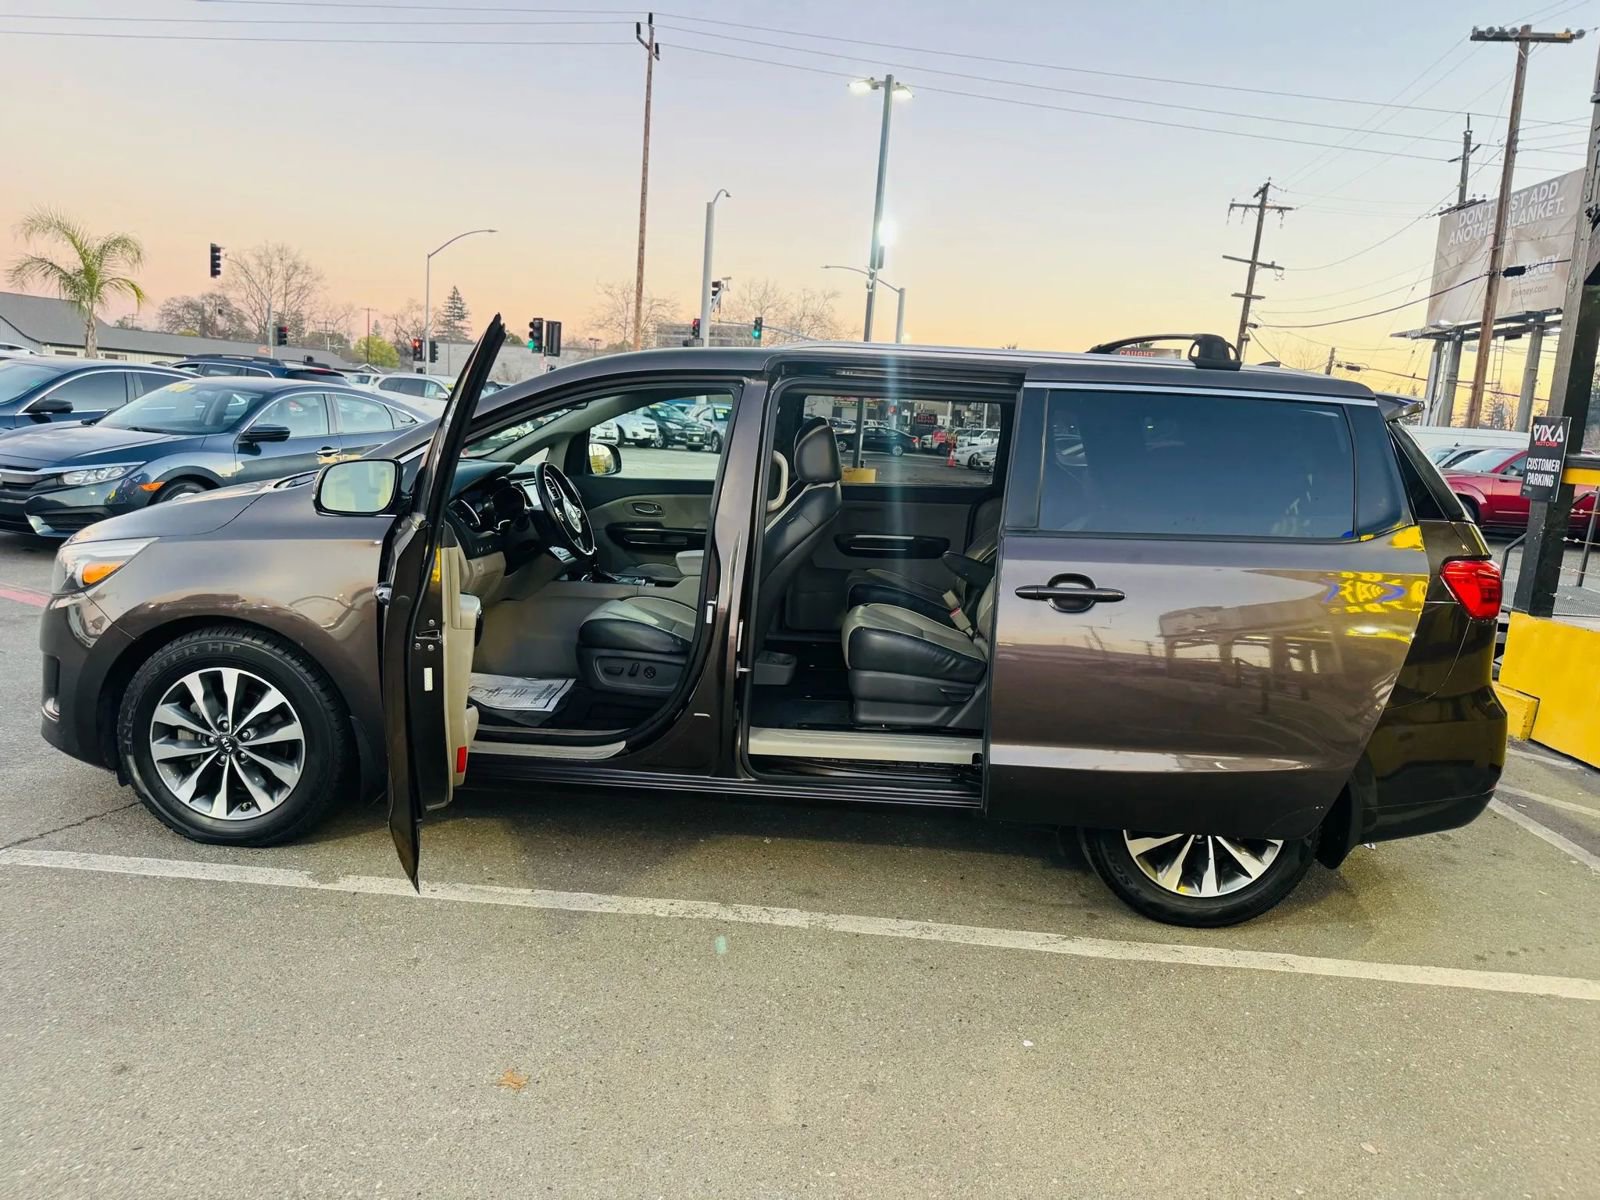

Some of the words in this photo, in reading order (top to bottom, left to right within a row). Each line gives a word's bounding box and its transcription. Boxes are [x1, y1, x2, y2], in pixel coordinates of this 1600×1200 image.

[1459, 203, 1495, 227] DON'T
[1511, 191, 1528, 211] ST
[1528, 181, 1559, 205] ADD
[1448, 219, 1496, 246] ANOTHE
[1120, 350, 1156, 358] CAUGHT
[1533, 424, 1564, 442] VIXA
[1526, 457, 1560, 472] CUSTOMER
[1526, 473, 1554, 487] PARKING
[221, 737, 233, 753] KIA
